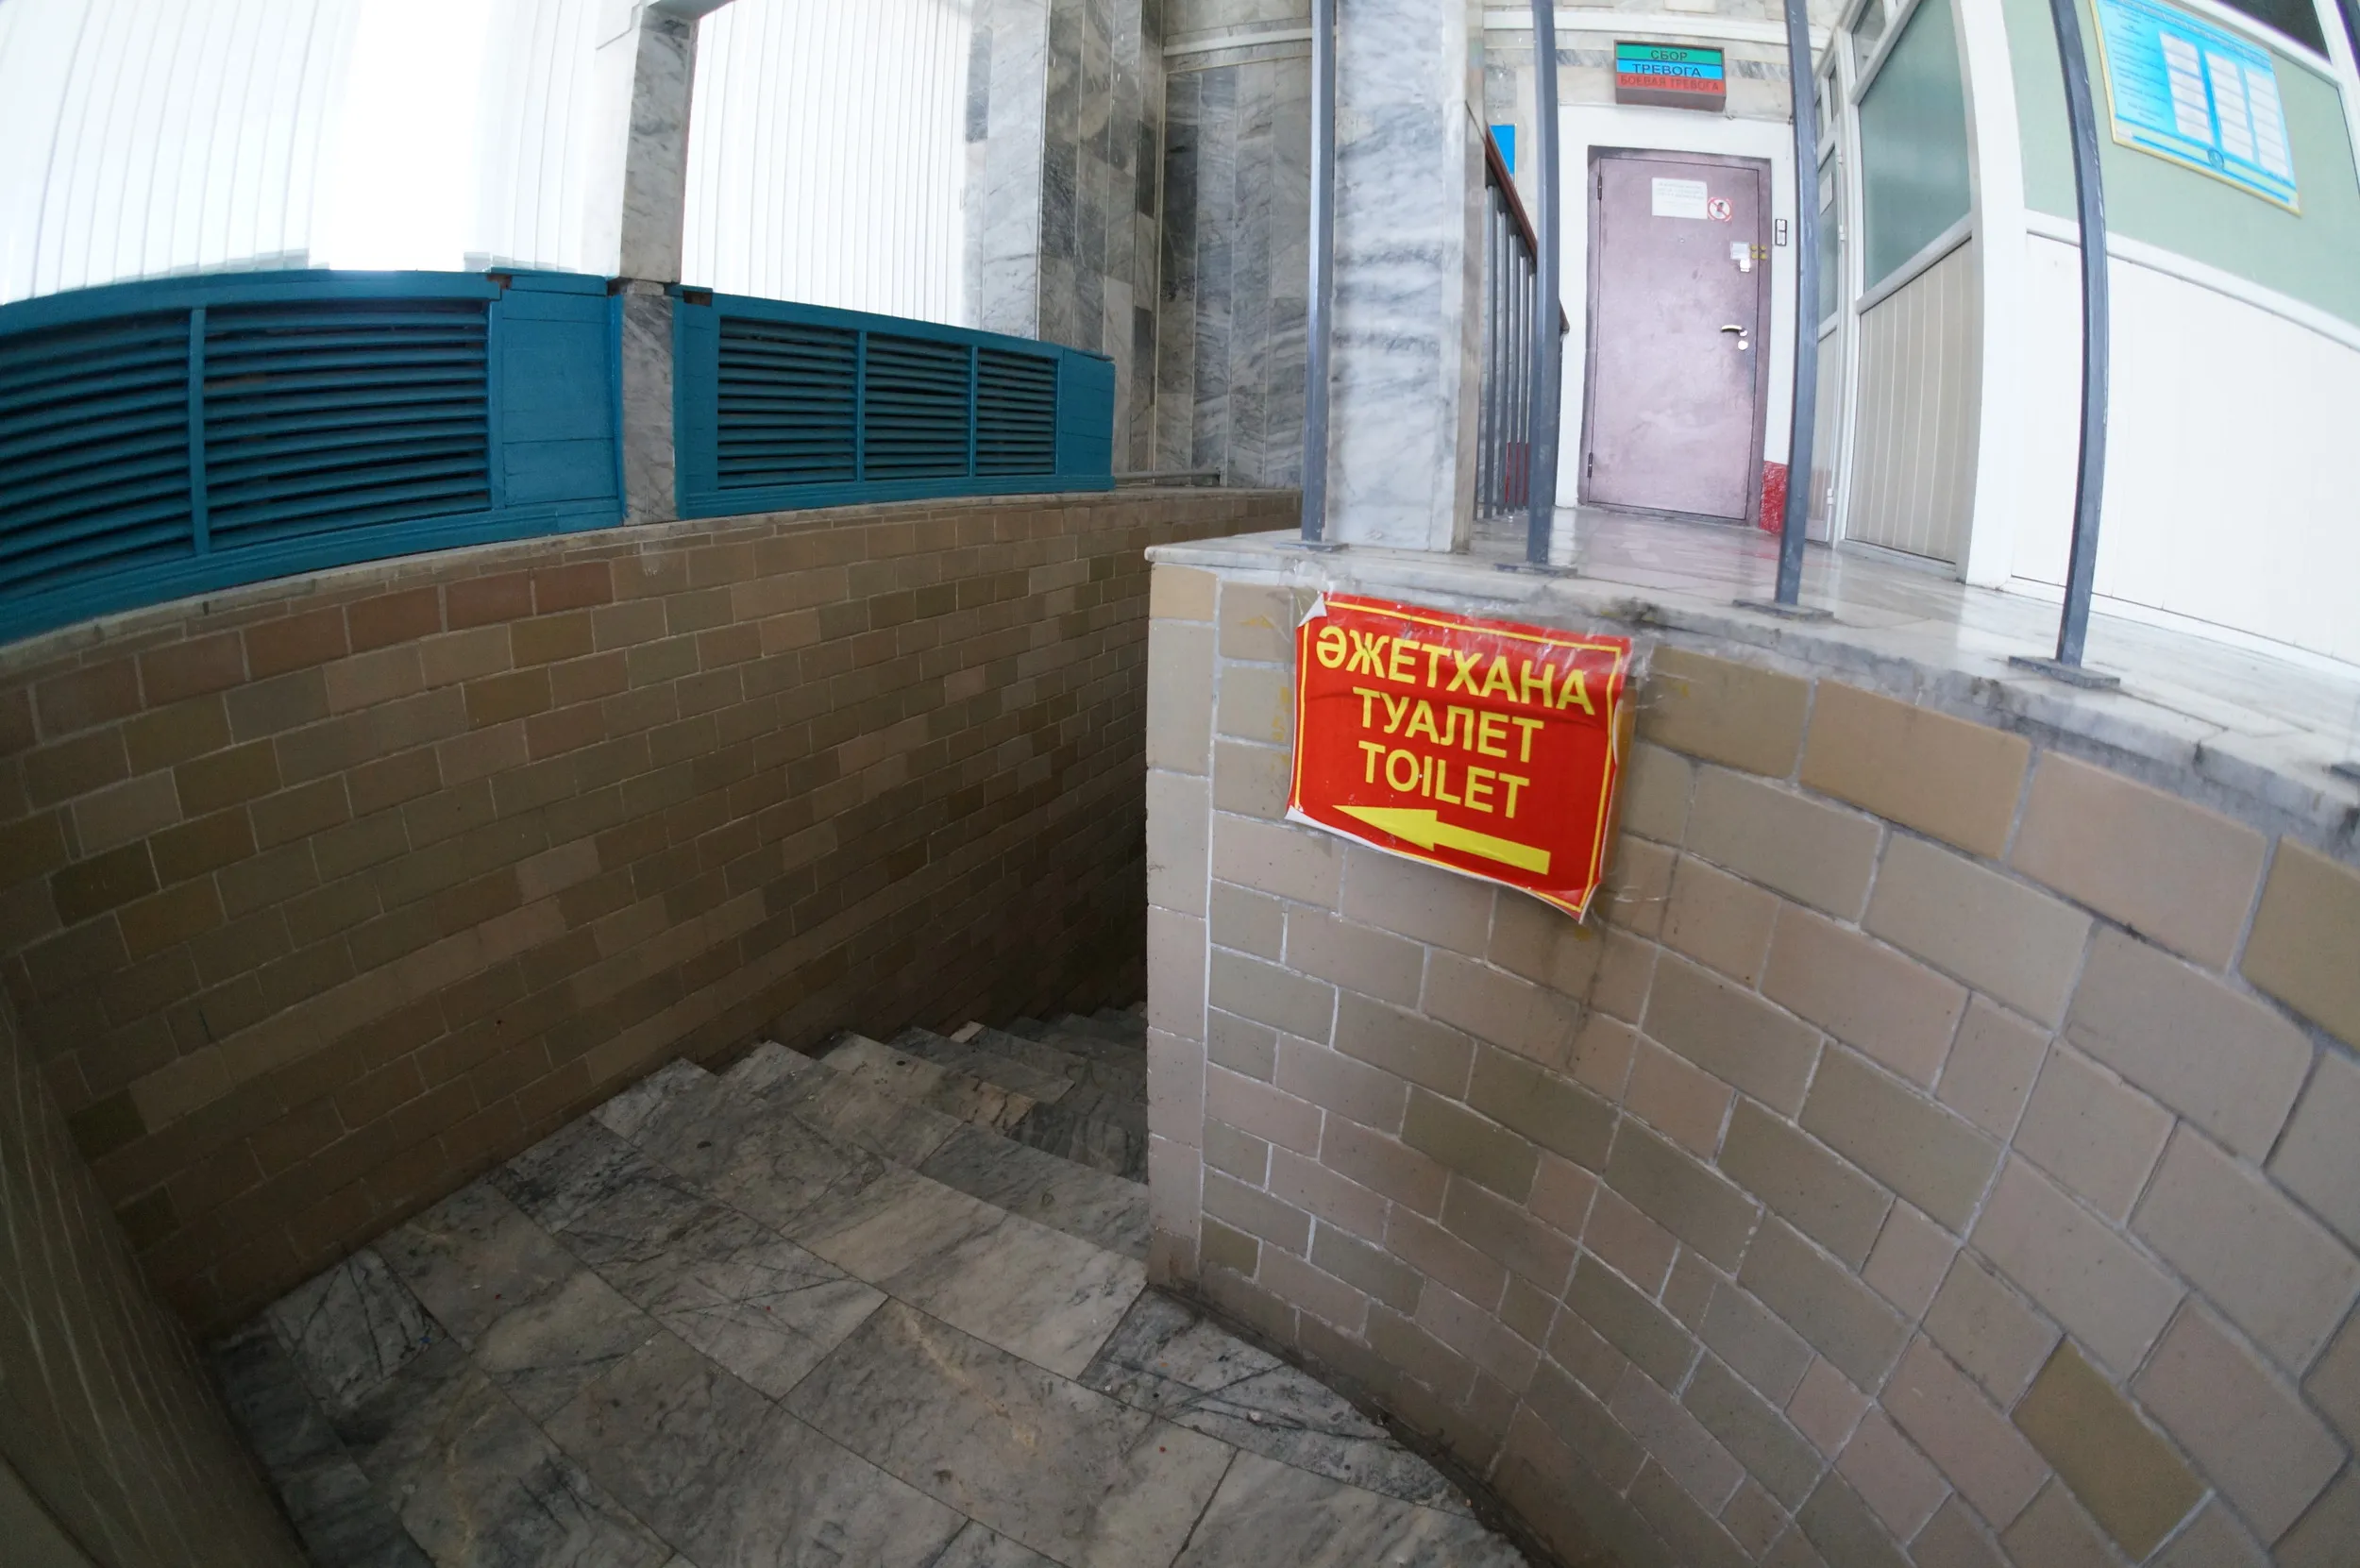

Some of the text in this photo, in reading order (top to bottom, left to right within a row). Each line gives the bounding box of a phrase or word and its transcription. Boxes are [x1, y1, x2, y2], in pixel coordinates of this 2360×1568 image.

[1632, 63, 1701, 76] ТРЕВОГА
[1650, 49, 1688, 61] СБОР
[1620, 75, 1719, 91] БОЕВАЯ ТРЕВОГА
[1316, 625, 1595, 716] ӘЖЕТХАНА
[1352, 686, 1544, 763] ТУАЛЕТ
[1357, 740, 1529, 818] TOILET
